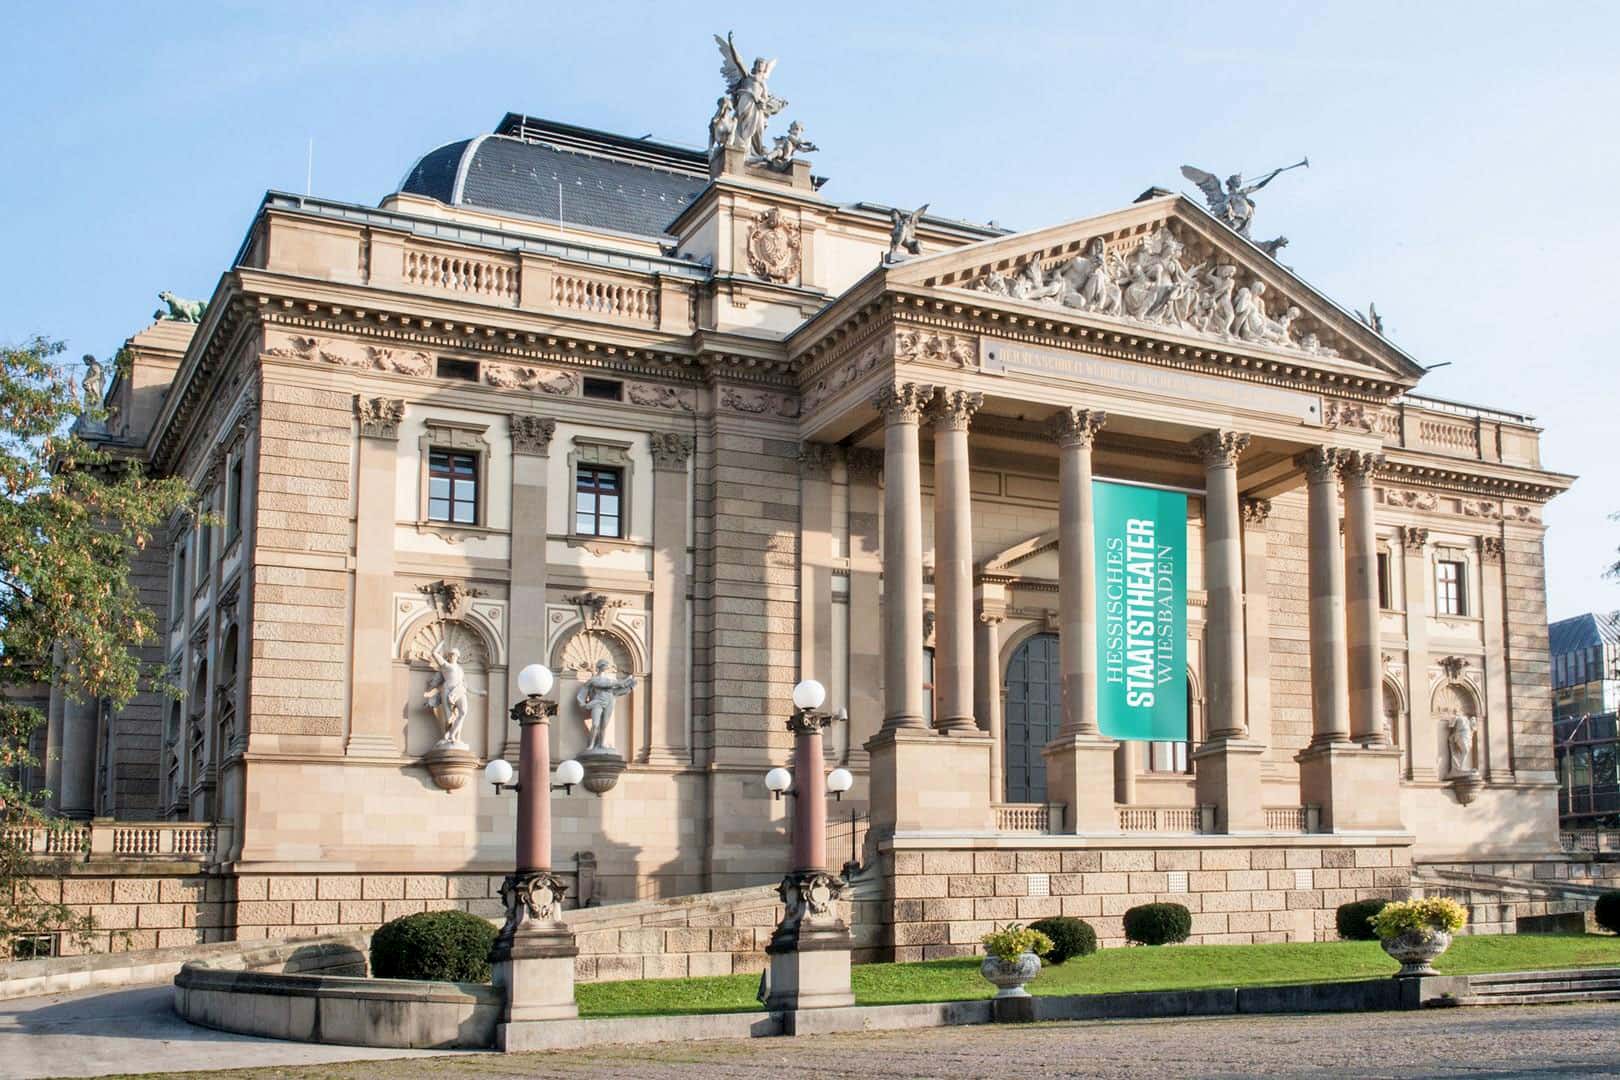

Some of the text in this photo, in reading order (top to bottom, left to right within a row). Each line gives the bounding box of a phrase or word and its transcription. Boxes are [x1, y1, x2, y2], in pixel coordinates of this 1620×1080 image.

[1106, 537, 1123, 683] HESSISCHES
[1126, 518, 1155, 707] STAATSTHEATER
[1158, 544, 1174, 685] WIESBADEN
